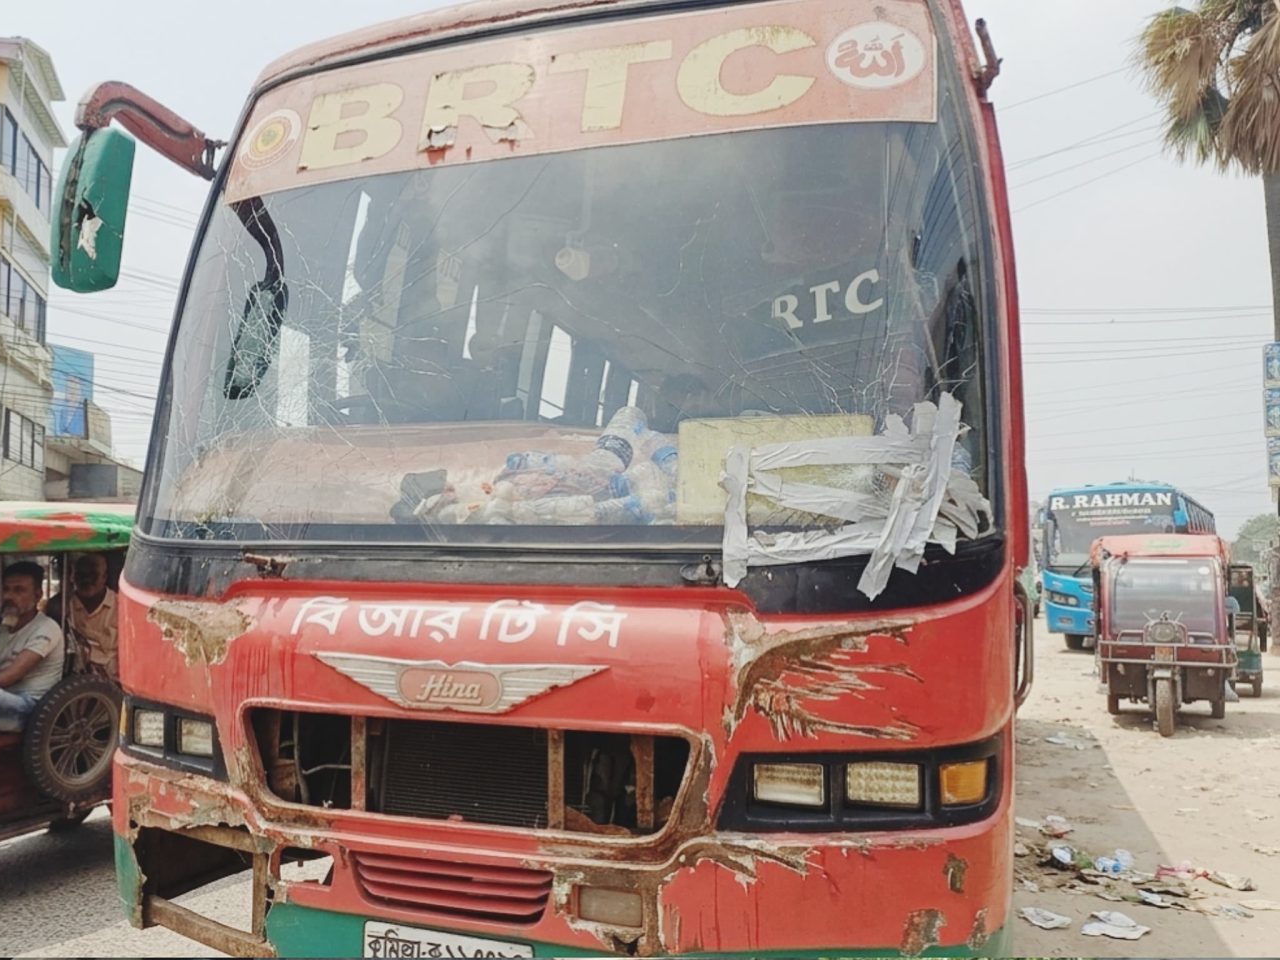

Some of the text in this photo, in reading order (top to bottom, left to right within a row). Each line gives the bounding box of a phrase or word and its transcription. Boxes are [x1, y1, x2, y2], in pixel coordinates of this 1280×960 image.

[295, 23, 818, 173] BRTC
[771, 268, 885, 329] RTC
[290, 597, 628, 648] বি আর টি সি
